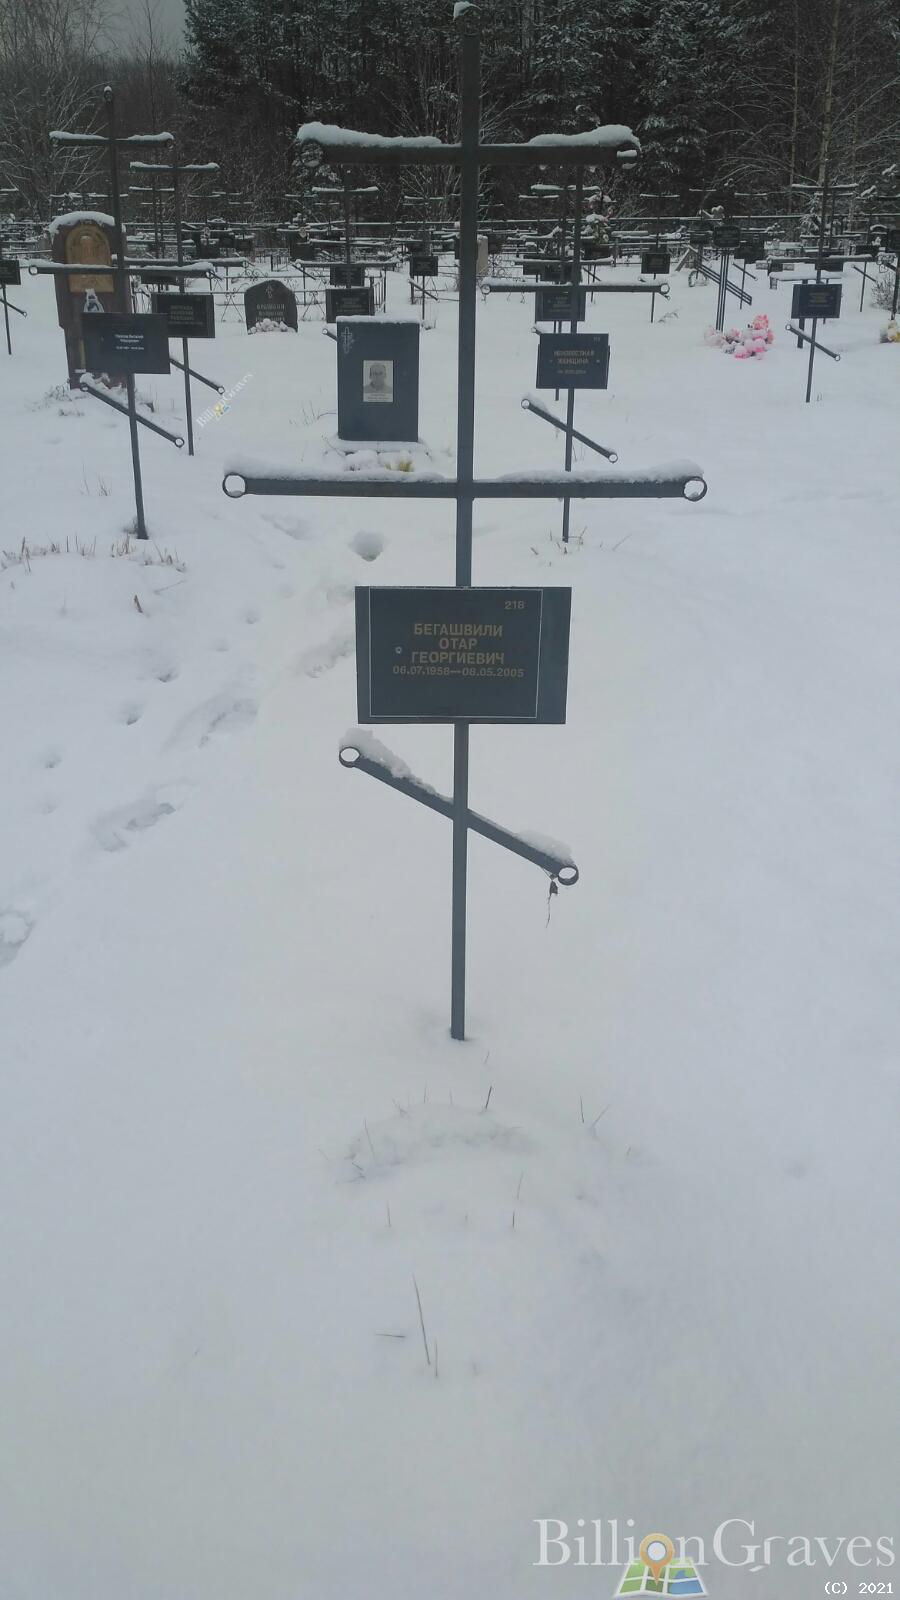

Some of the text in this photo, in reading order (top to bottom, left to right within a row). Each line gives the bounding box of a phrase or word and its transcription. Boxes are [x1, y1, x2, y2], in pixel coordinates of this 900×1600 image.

[504, 600, 525, 610] 218
[414, 623, 503, 637] БЕГАШВИЛИ
[439, 637, 478, 650] ОТАР
[411, 651, 505, 664] ГЕОРГИЕВИЧ
